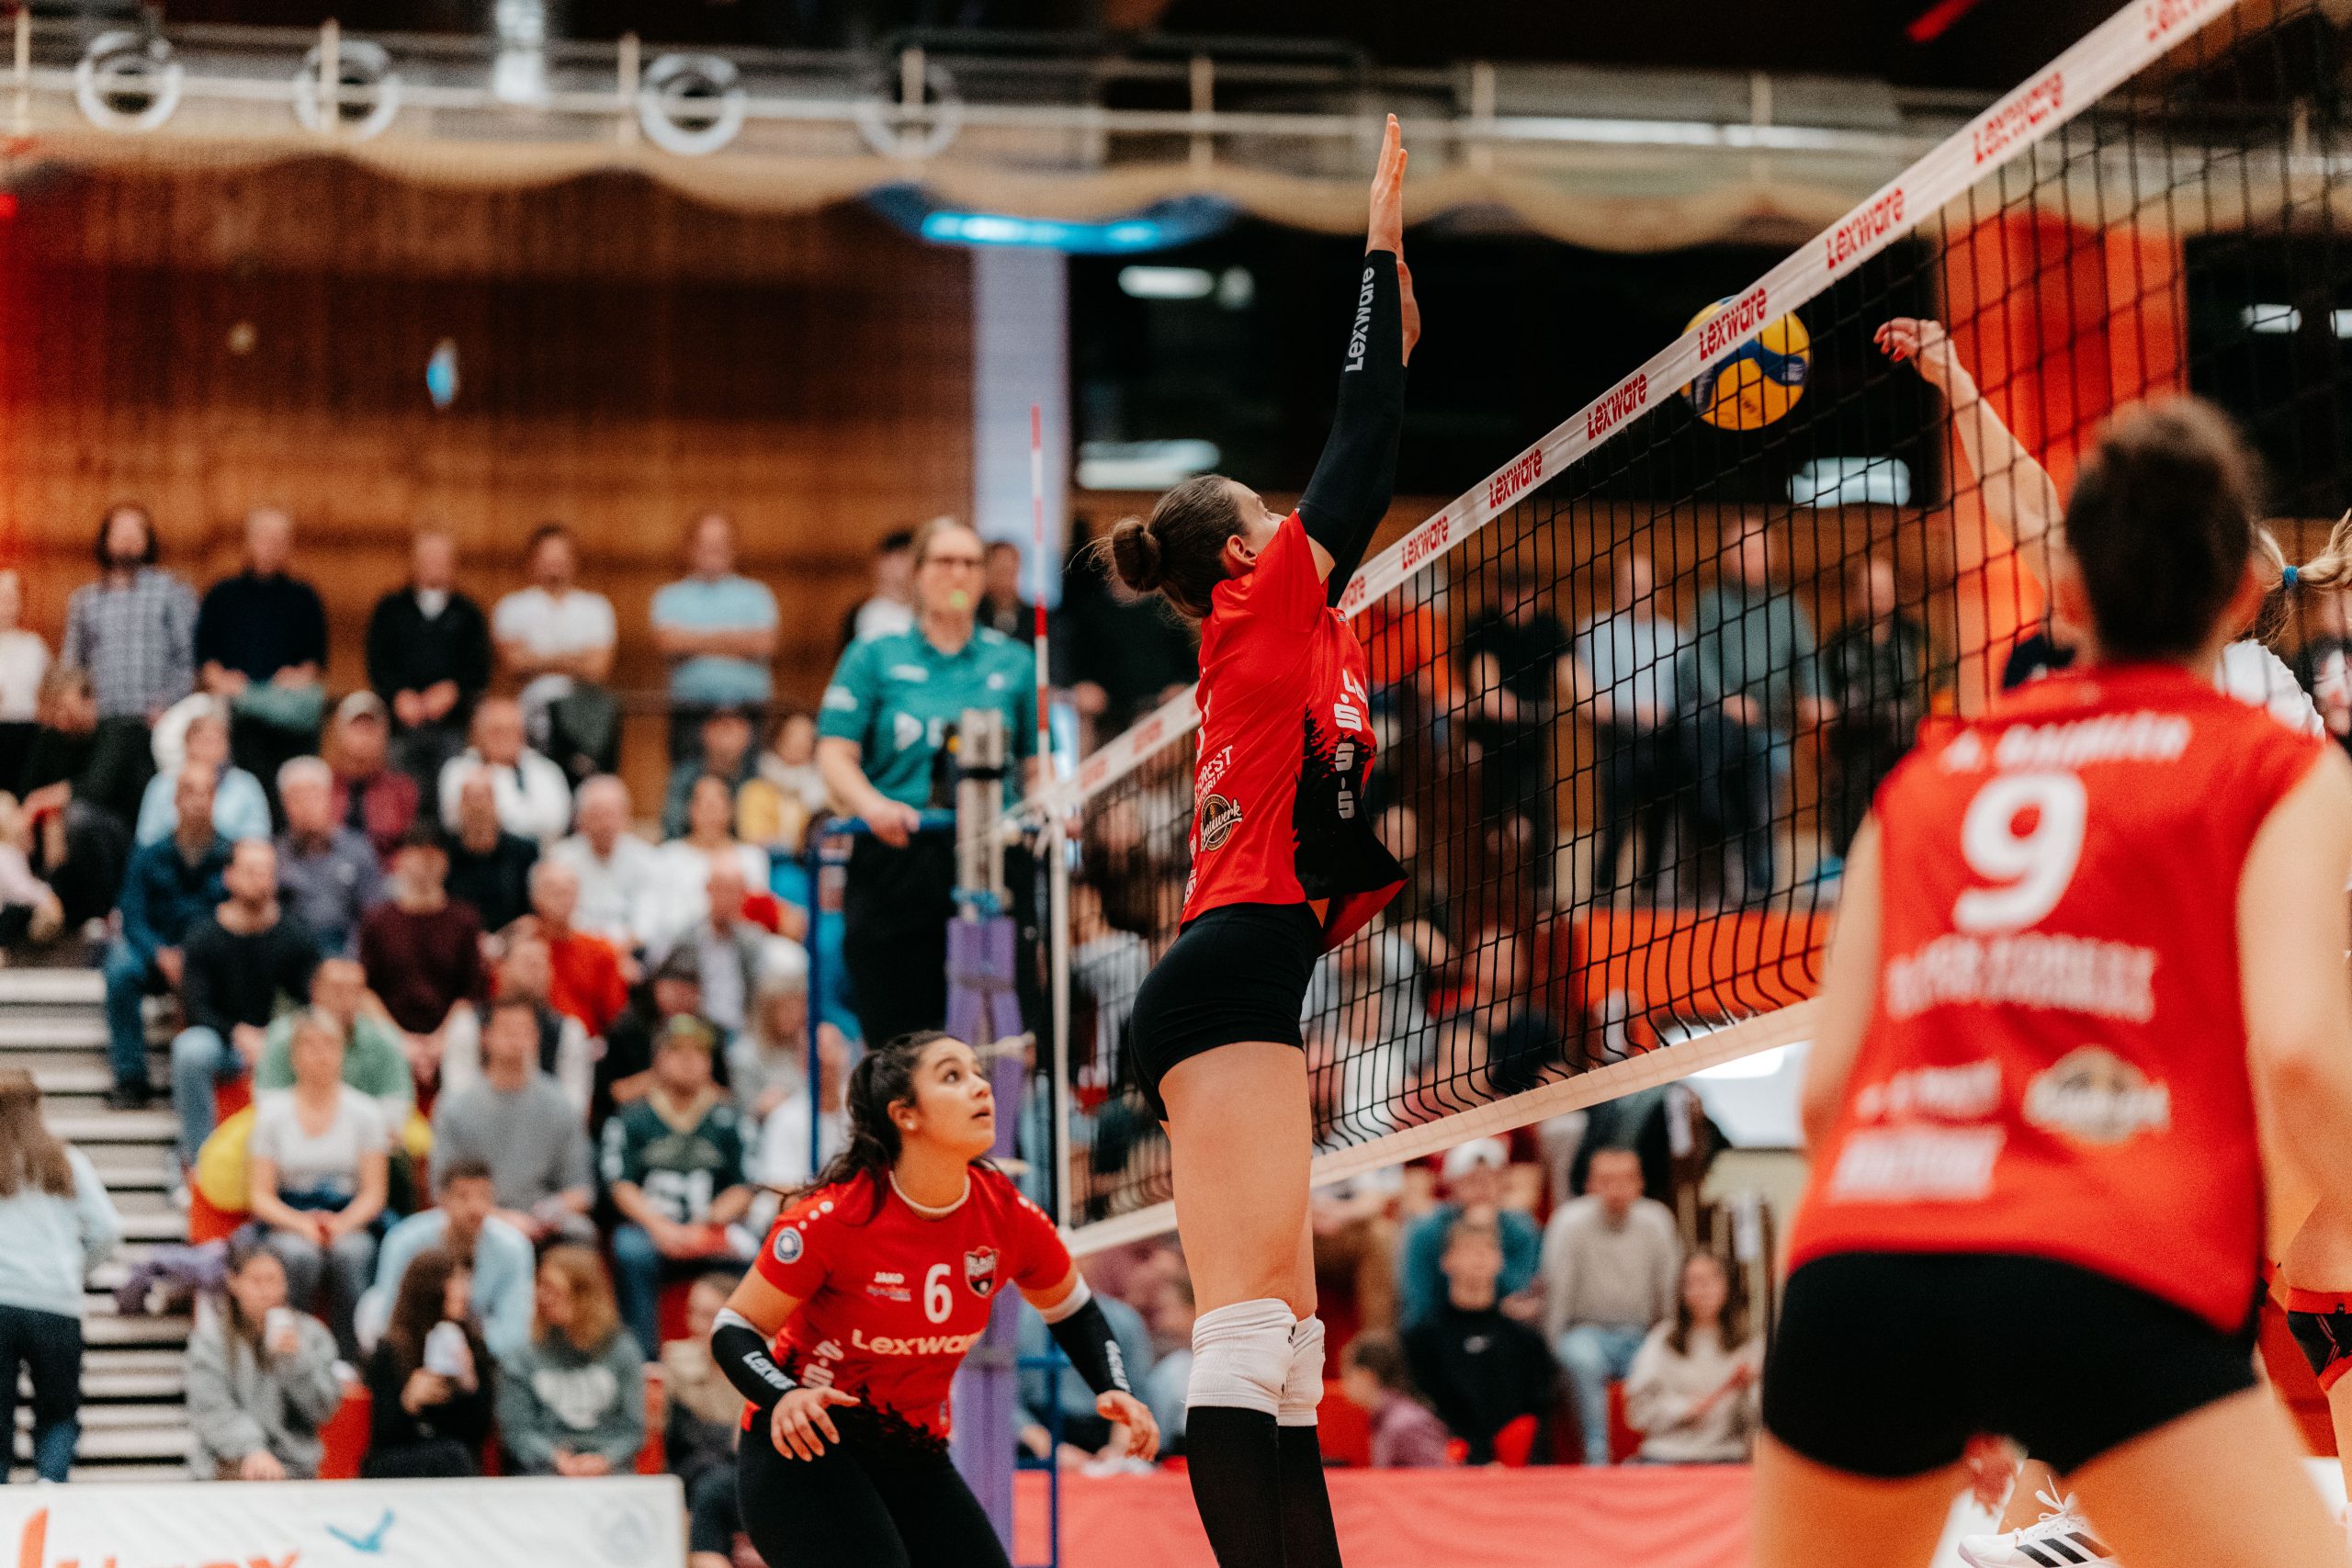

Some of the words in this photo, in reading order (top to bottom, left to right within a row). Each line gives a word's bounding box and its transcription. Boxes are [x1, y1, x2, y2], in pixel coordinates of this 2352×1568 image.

[1826, 187, 1905, 270] Lexware
[1345, 267, 1375, 372] Lexware
[1699, 288, 1767, 361] Lexware
[1588, 373, 1647, 441] Lexware
[1489, 448, 1543, 509] Lexware
[1402, 515, 1449, 570] Lexware
[1957, 773, 2087, 931] 9
[924, 1263, 953, 1324] 6
